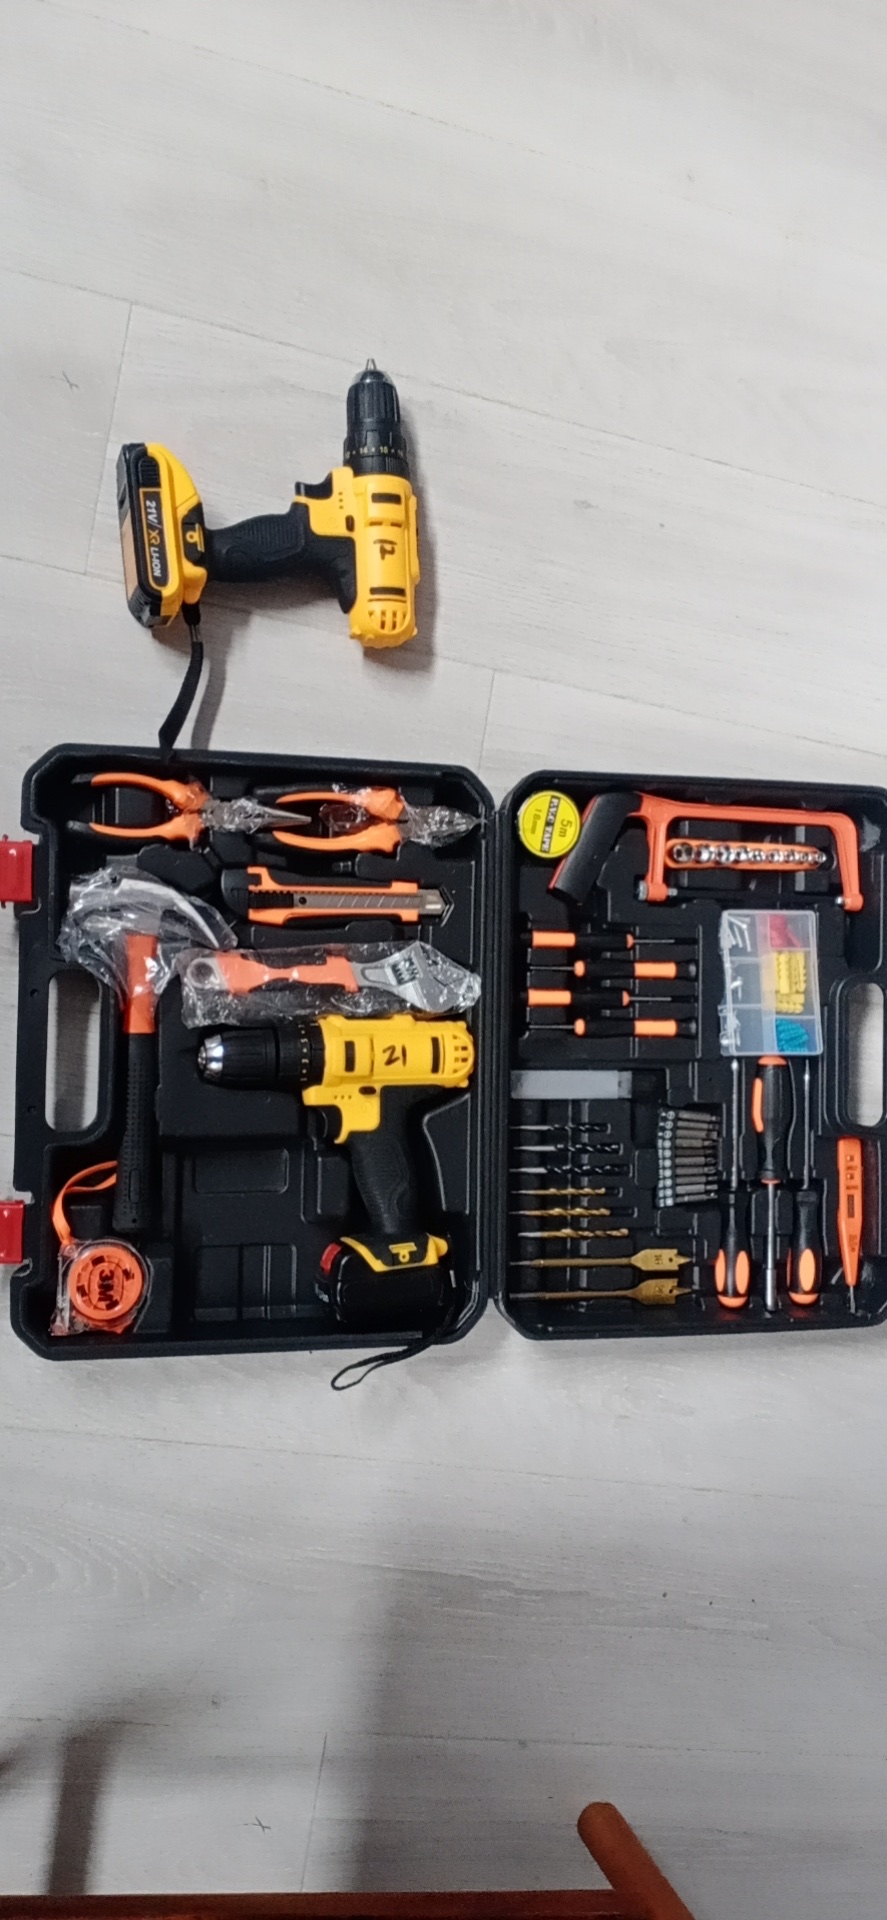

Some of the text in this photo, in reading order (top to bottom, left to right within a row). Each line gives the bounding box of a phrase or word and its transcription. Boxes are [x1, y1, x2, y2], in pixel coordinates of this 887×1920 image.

[148, 529, 160, 544] XR
[150, 547, 162, 578] LI-ION
[541, 825, 554, 853] TAPE
[558, 818, 573, 838] 5m
[97, 1269, 115, 1302] 3M
